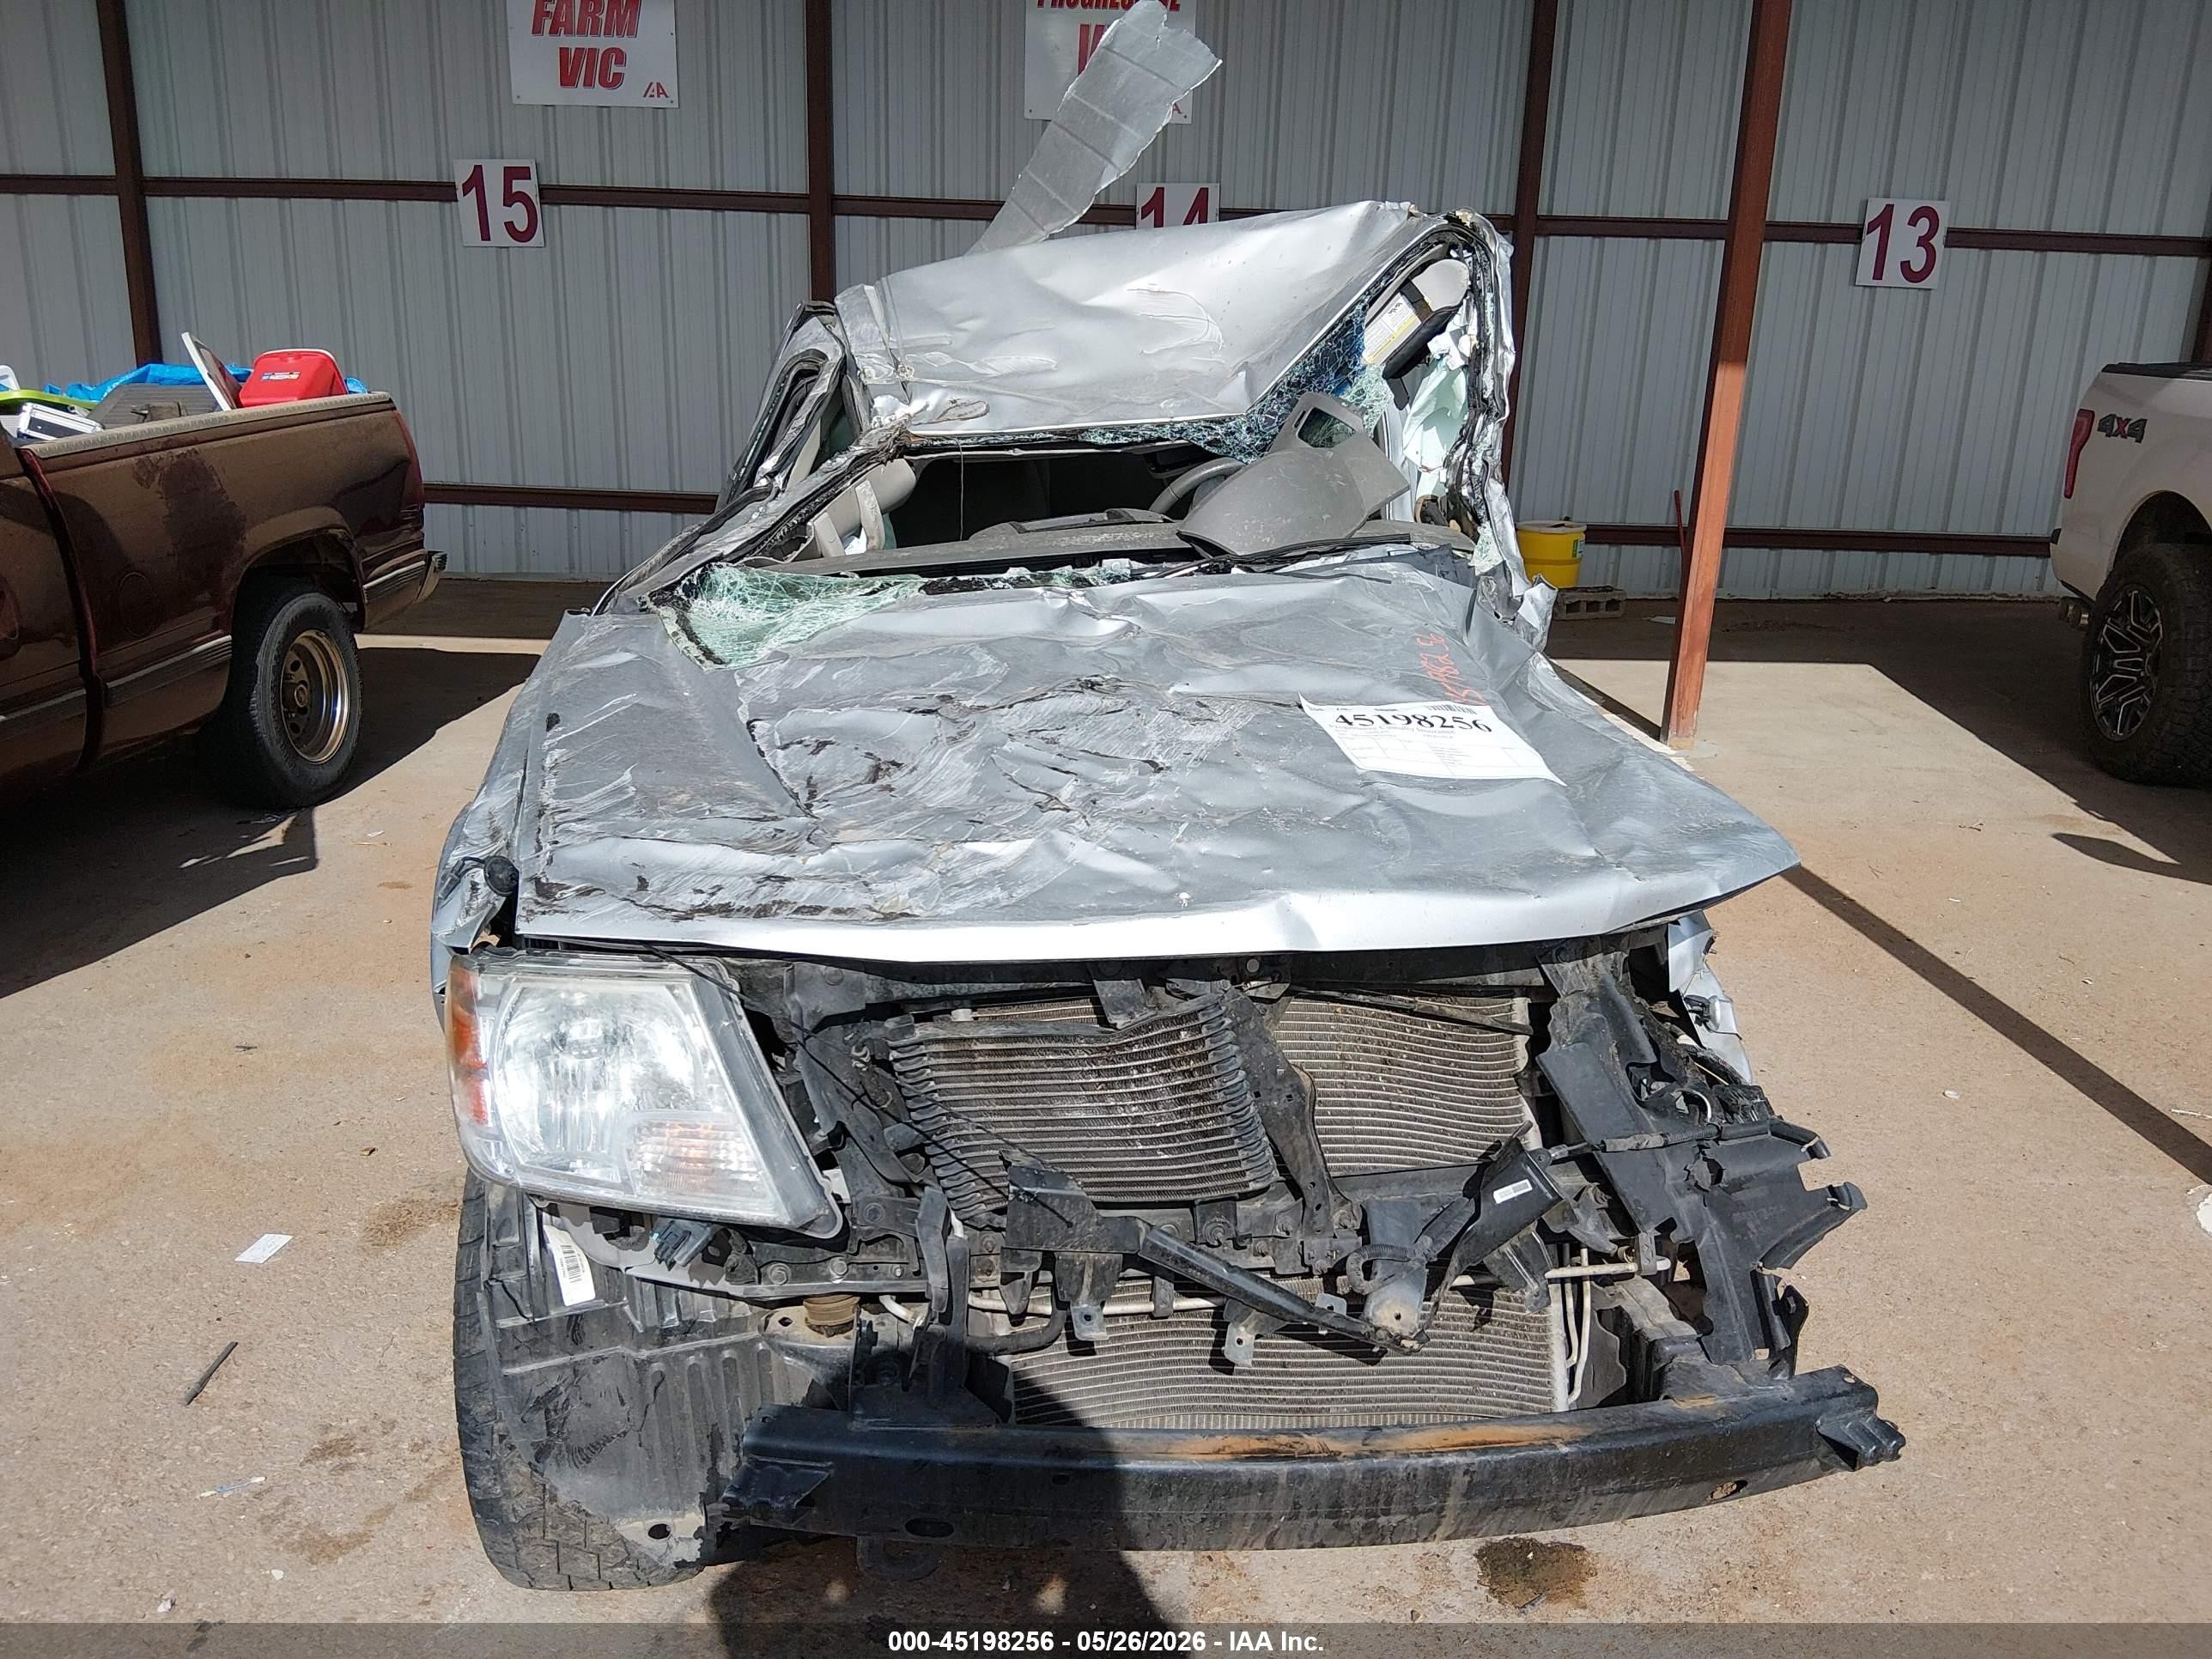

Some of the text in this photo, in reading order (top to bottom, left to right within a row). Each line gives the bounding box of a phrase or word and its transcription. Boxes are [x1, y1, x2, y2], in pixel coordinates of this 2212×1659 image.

[532, 0, 642, 38] FARM
[559, 46, 627, 89] VIC
[462, 165, 538, 243] 15
[1866, 204, 1940, 283] 13
[1335, 714, 1492, 732] 45198256
